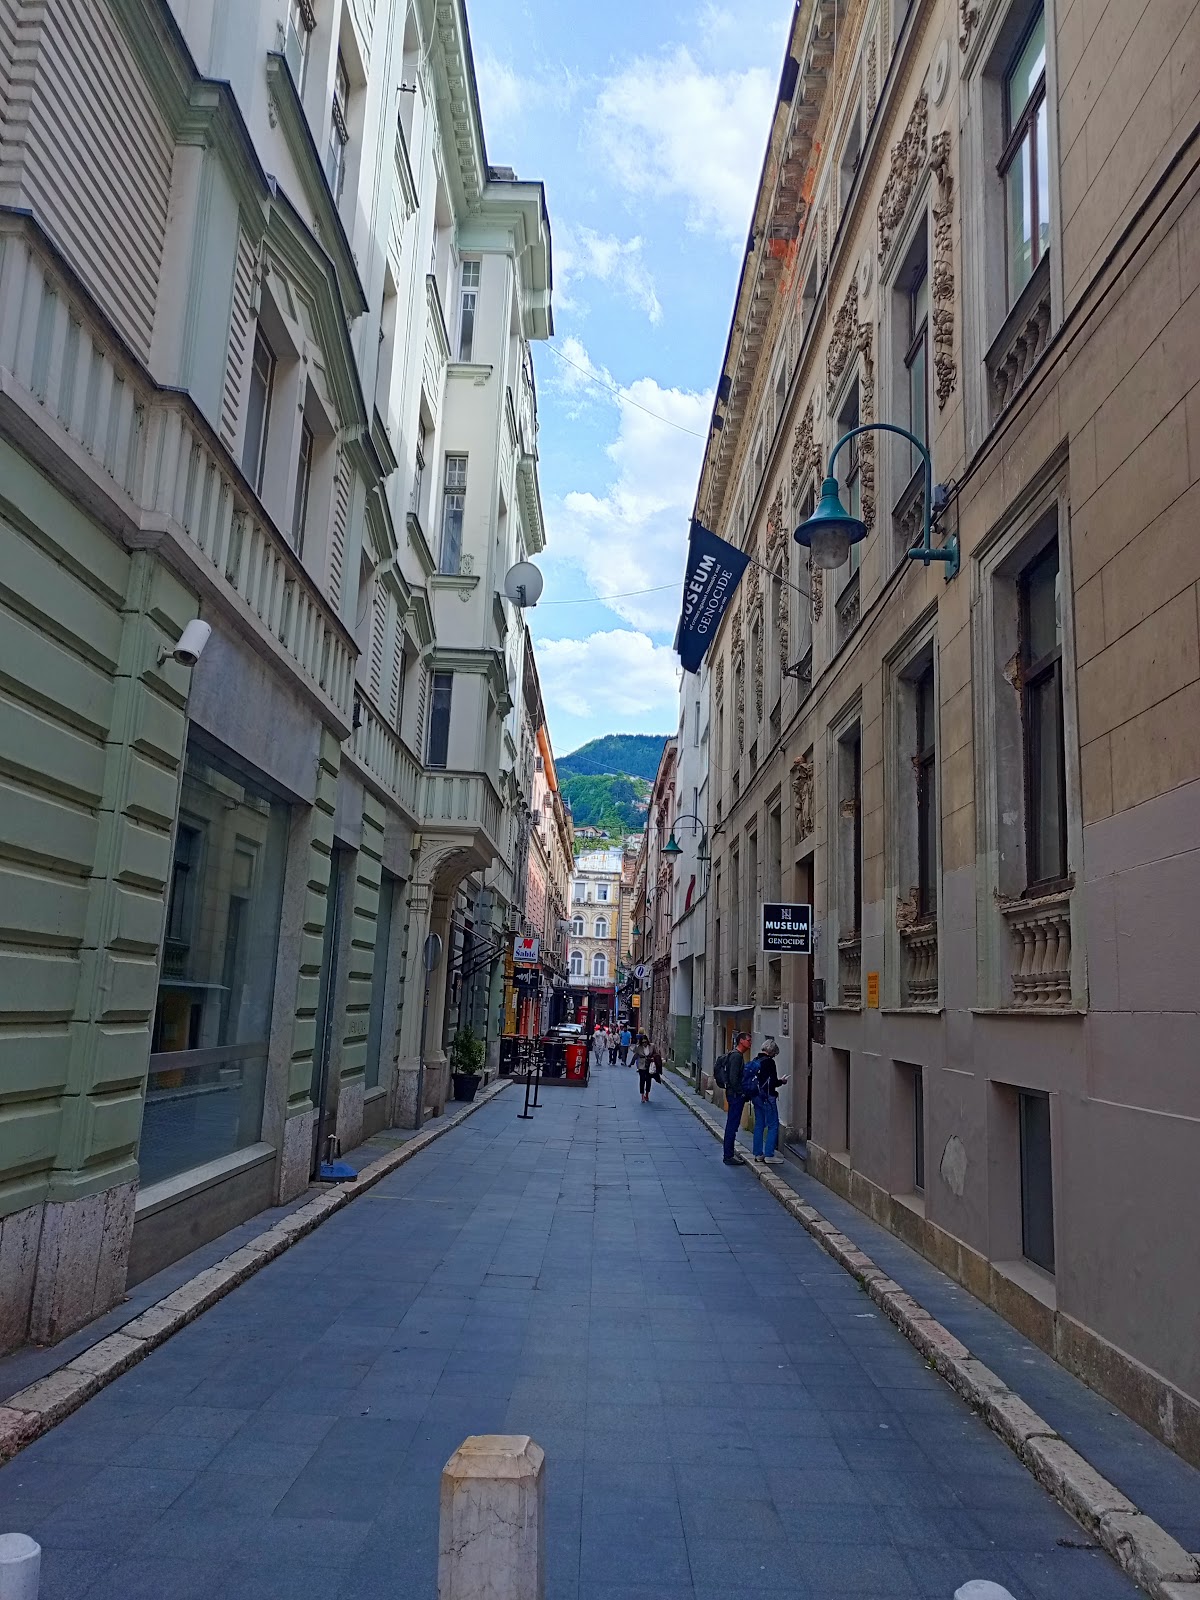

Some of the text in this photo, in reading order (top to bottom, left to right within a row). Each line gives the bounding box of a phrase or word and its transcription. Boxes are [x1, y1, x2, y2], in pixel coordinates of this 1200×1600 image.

[697, 569, 733, 634] GENOCIDE
[765, 920, 808, 931] MUSEUM
[767, 937, 805, 946] GENOCIDE
